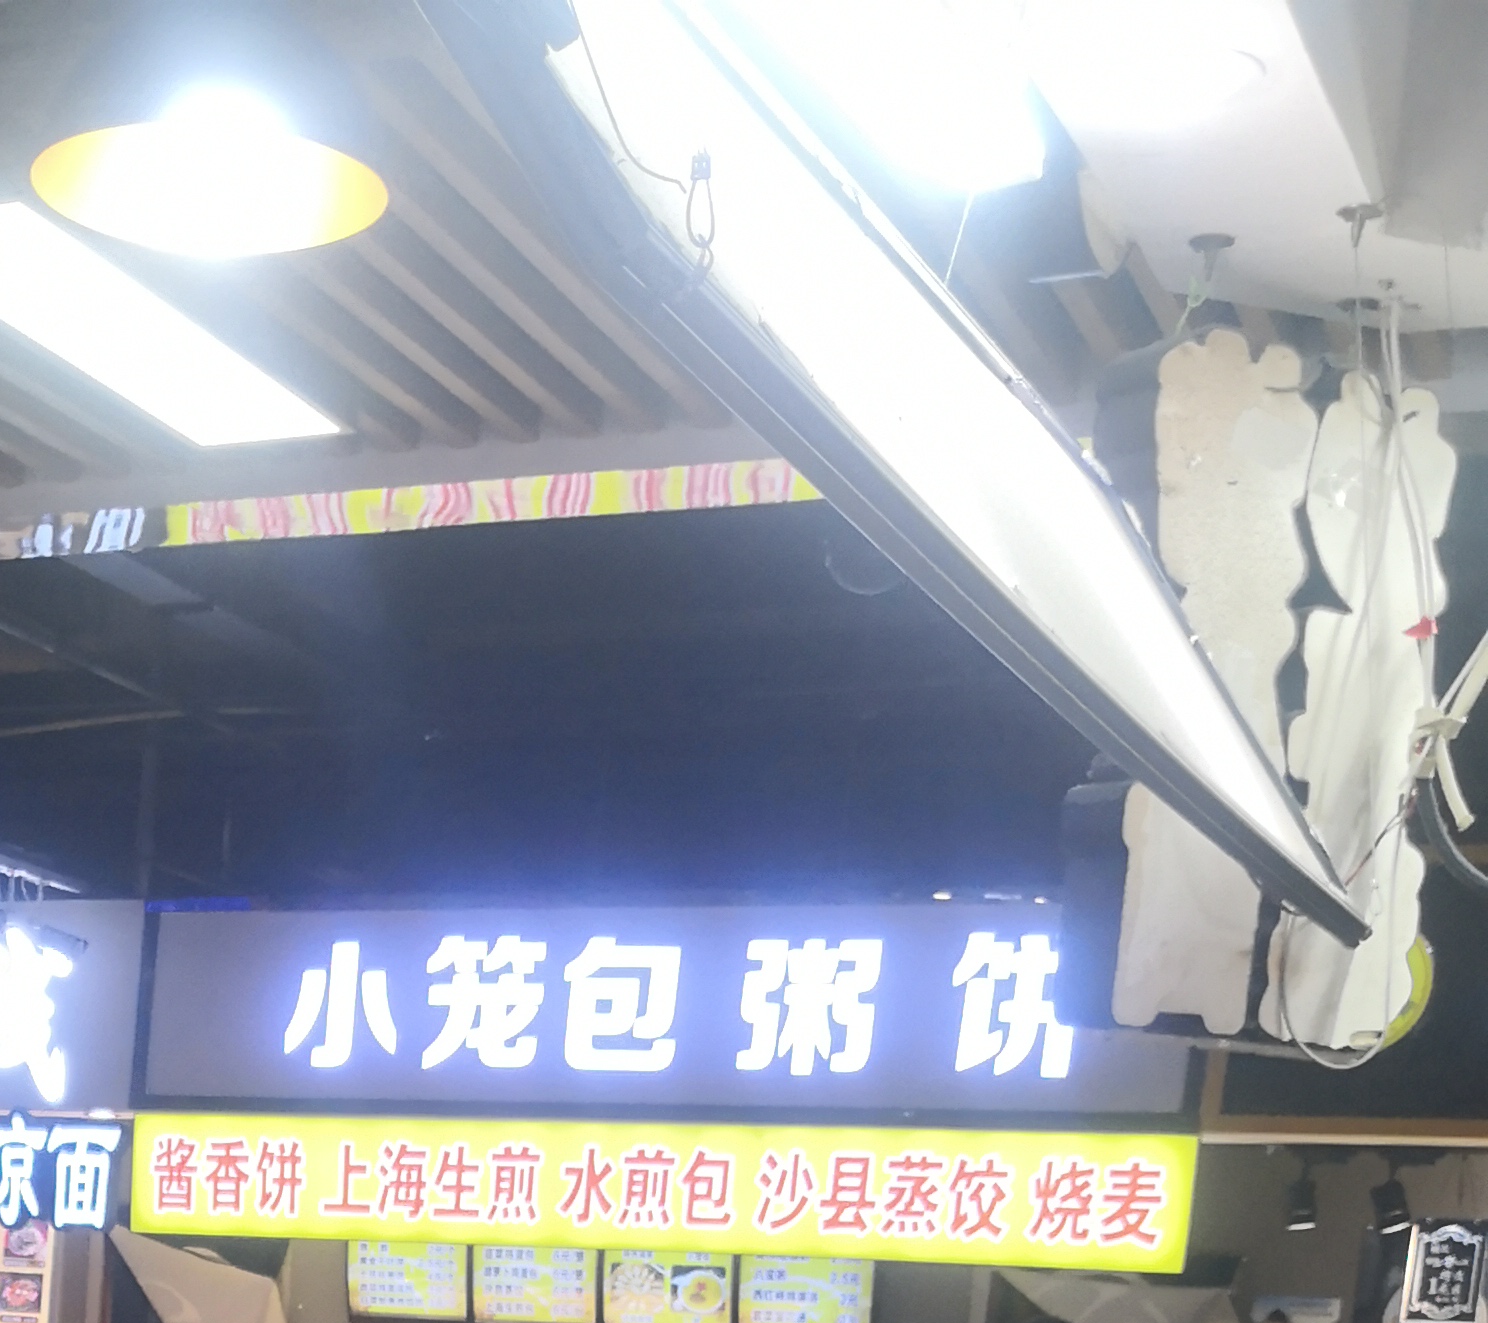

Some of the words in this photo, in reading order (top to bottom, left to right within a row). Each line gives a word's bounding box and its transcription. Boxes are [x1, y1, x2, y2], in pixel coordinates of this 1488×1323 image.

[284, 935, 682, 1074] 小笼包
[736, 938, 884, 1077] 粥
[952, 931, 1075, 1079] 饼
[154, 1137, 303, 1214] 酱香饼
[323, 1143, 541, 1222] 上海生煎
[559, 1148, 732, 1227] 水煎包
[757, 1153, 1009, 1237] 沙县蒸饺
[1029, 1160, 1162, 1245] 烧麦
